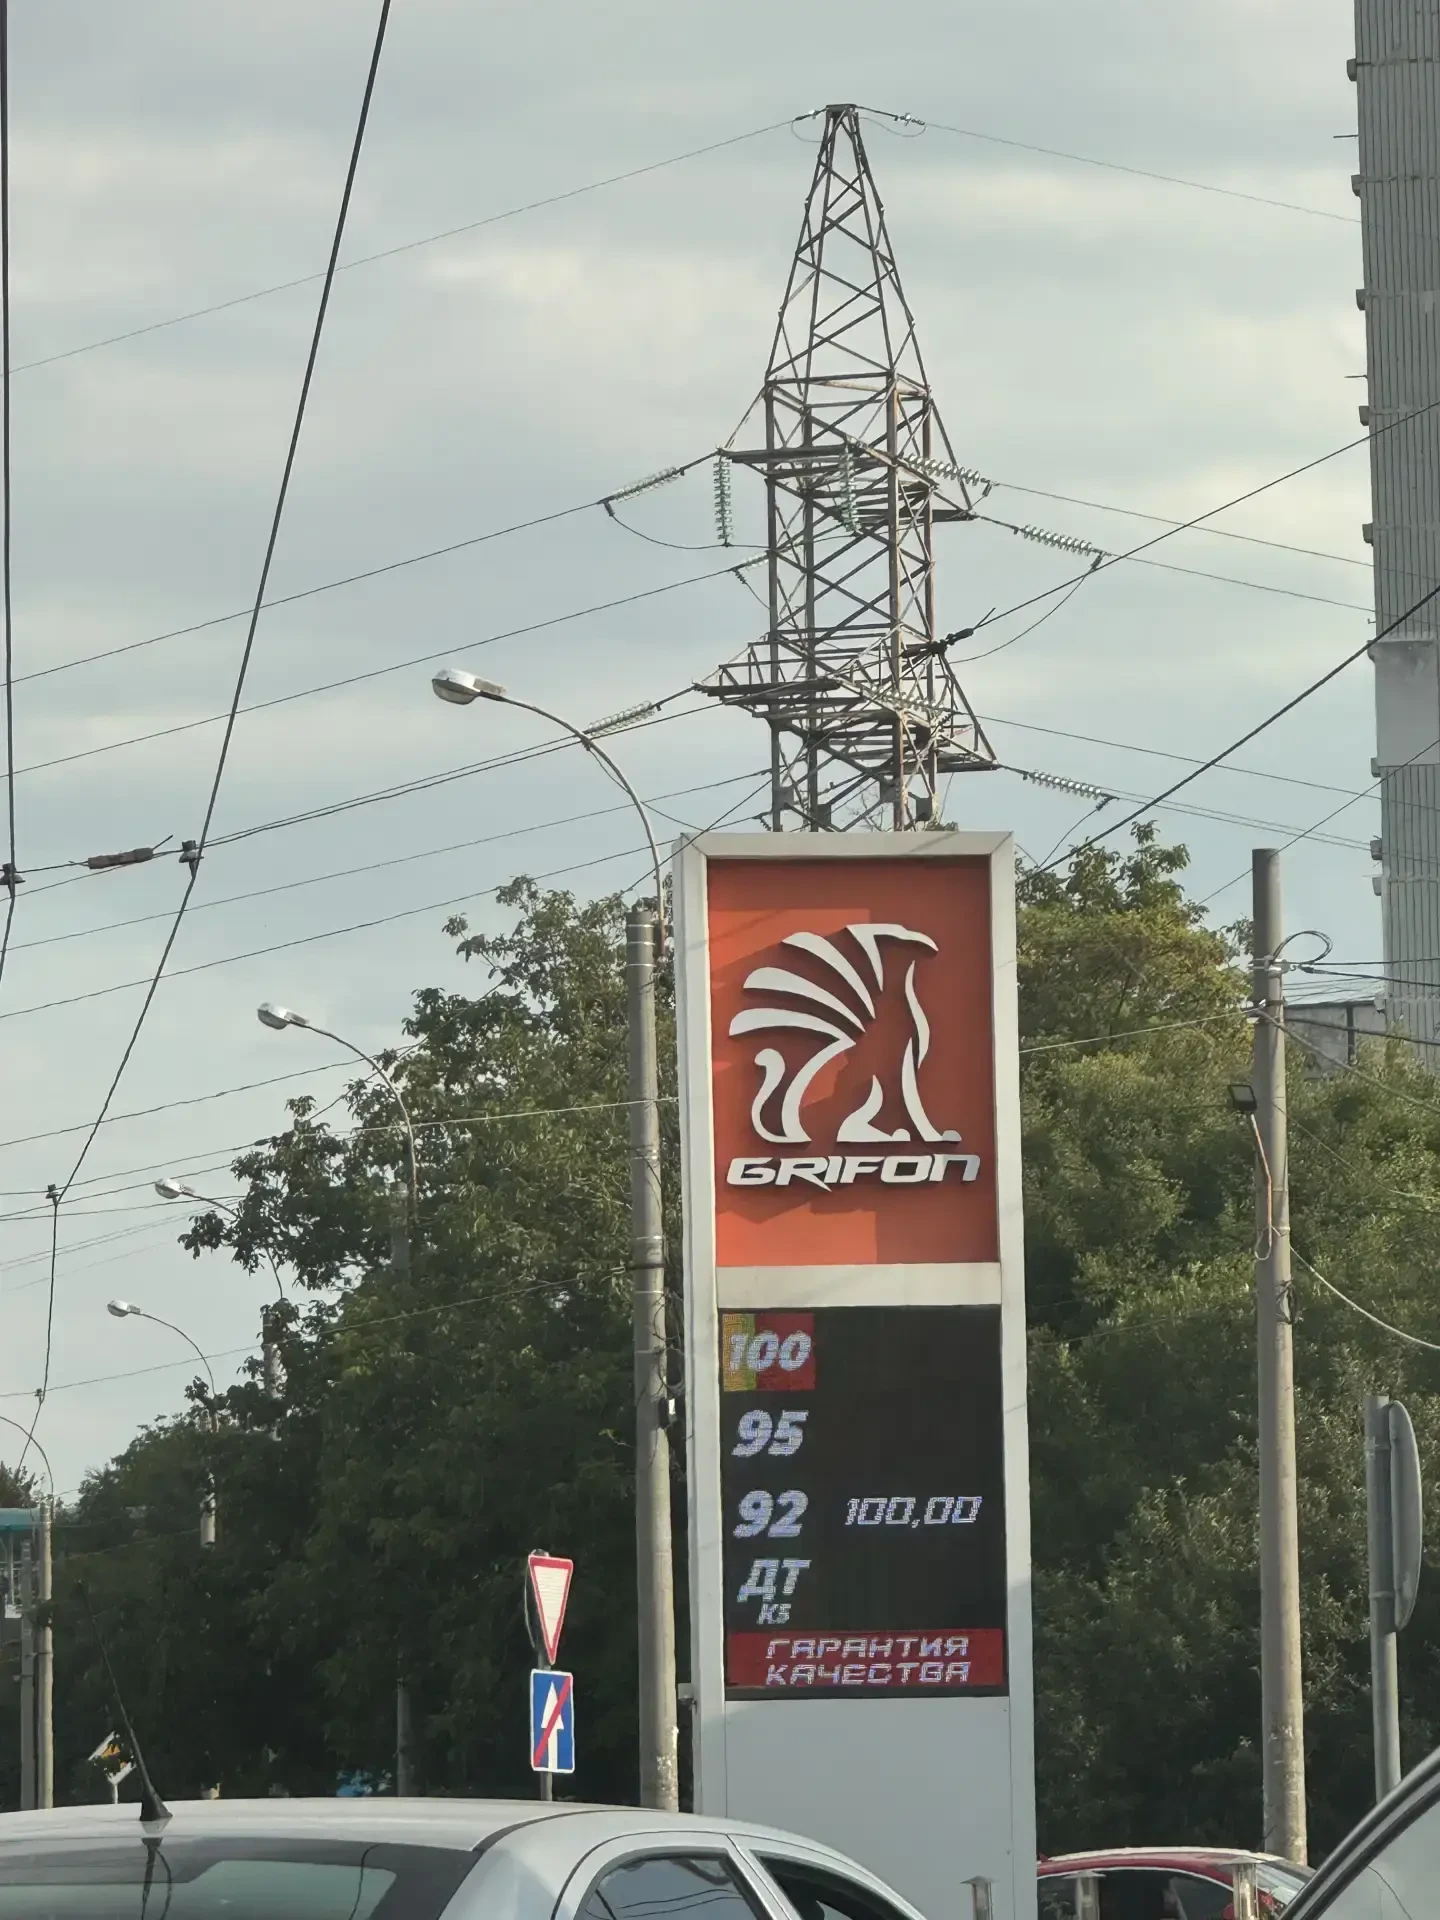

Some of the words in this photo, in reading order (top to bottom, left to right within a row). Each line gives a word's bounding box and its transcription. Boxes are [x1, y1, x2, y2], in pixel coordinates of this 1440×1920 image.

[726, 1153, 981, 1192] GRIFON
[729, 1330, 812, 1372] 100
[731, 1409, 810, 1457] 95
[732, 1490, 809, 1538] 92
[845, 1496, 982, 1528] 100,00
[736, 1559, 812, 1603] ДТ
[765, 1636, 969, 1660] ГАРАНТИЯ
[765, 1661, 971, 1685] КАЧЕСТВА
